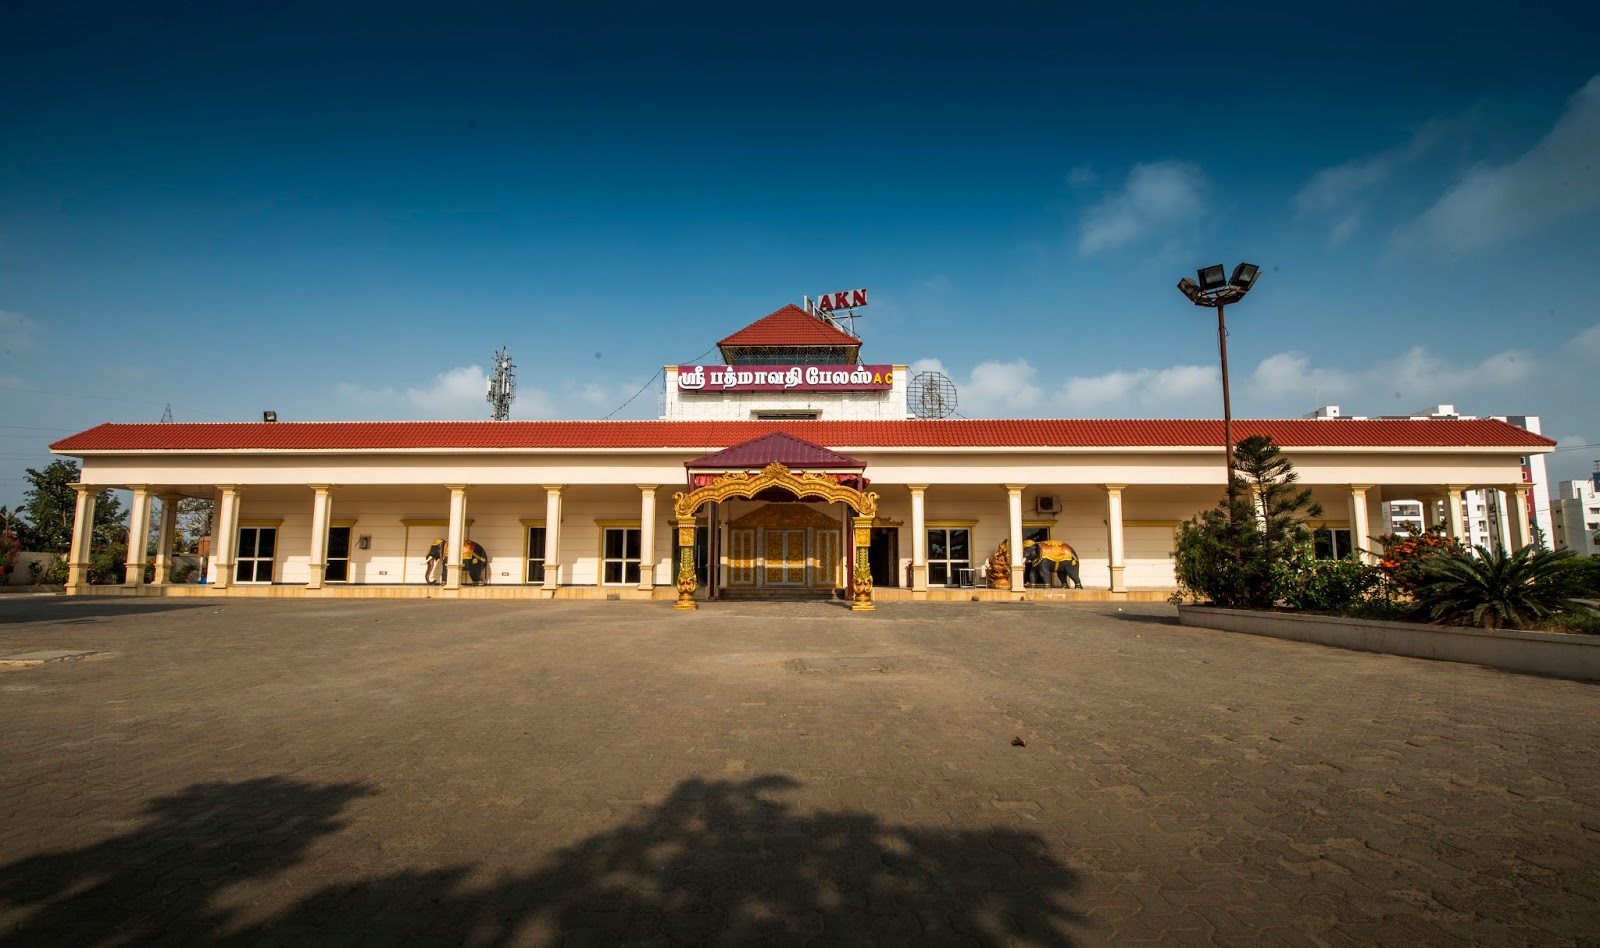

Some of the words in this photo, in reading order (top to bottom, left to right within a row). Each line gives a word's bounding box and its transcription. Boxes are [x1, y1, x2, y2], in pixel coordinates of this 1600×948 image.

[819, 288, 867, 311] AKN
[678, 366, 705, 389] ஸ்ரீ
[710, 366, 803, 389] பத்மாவதி
[805, 366, 873, 385] பேலஸ்
